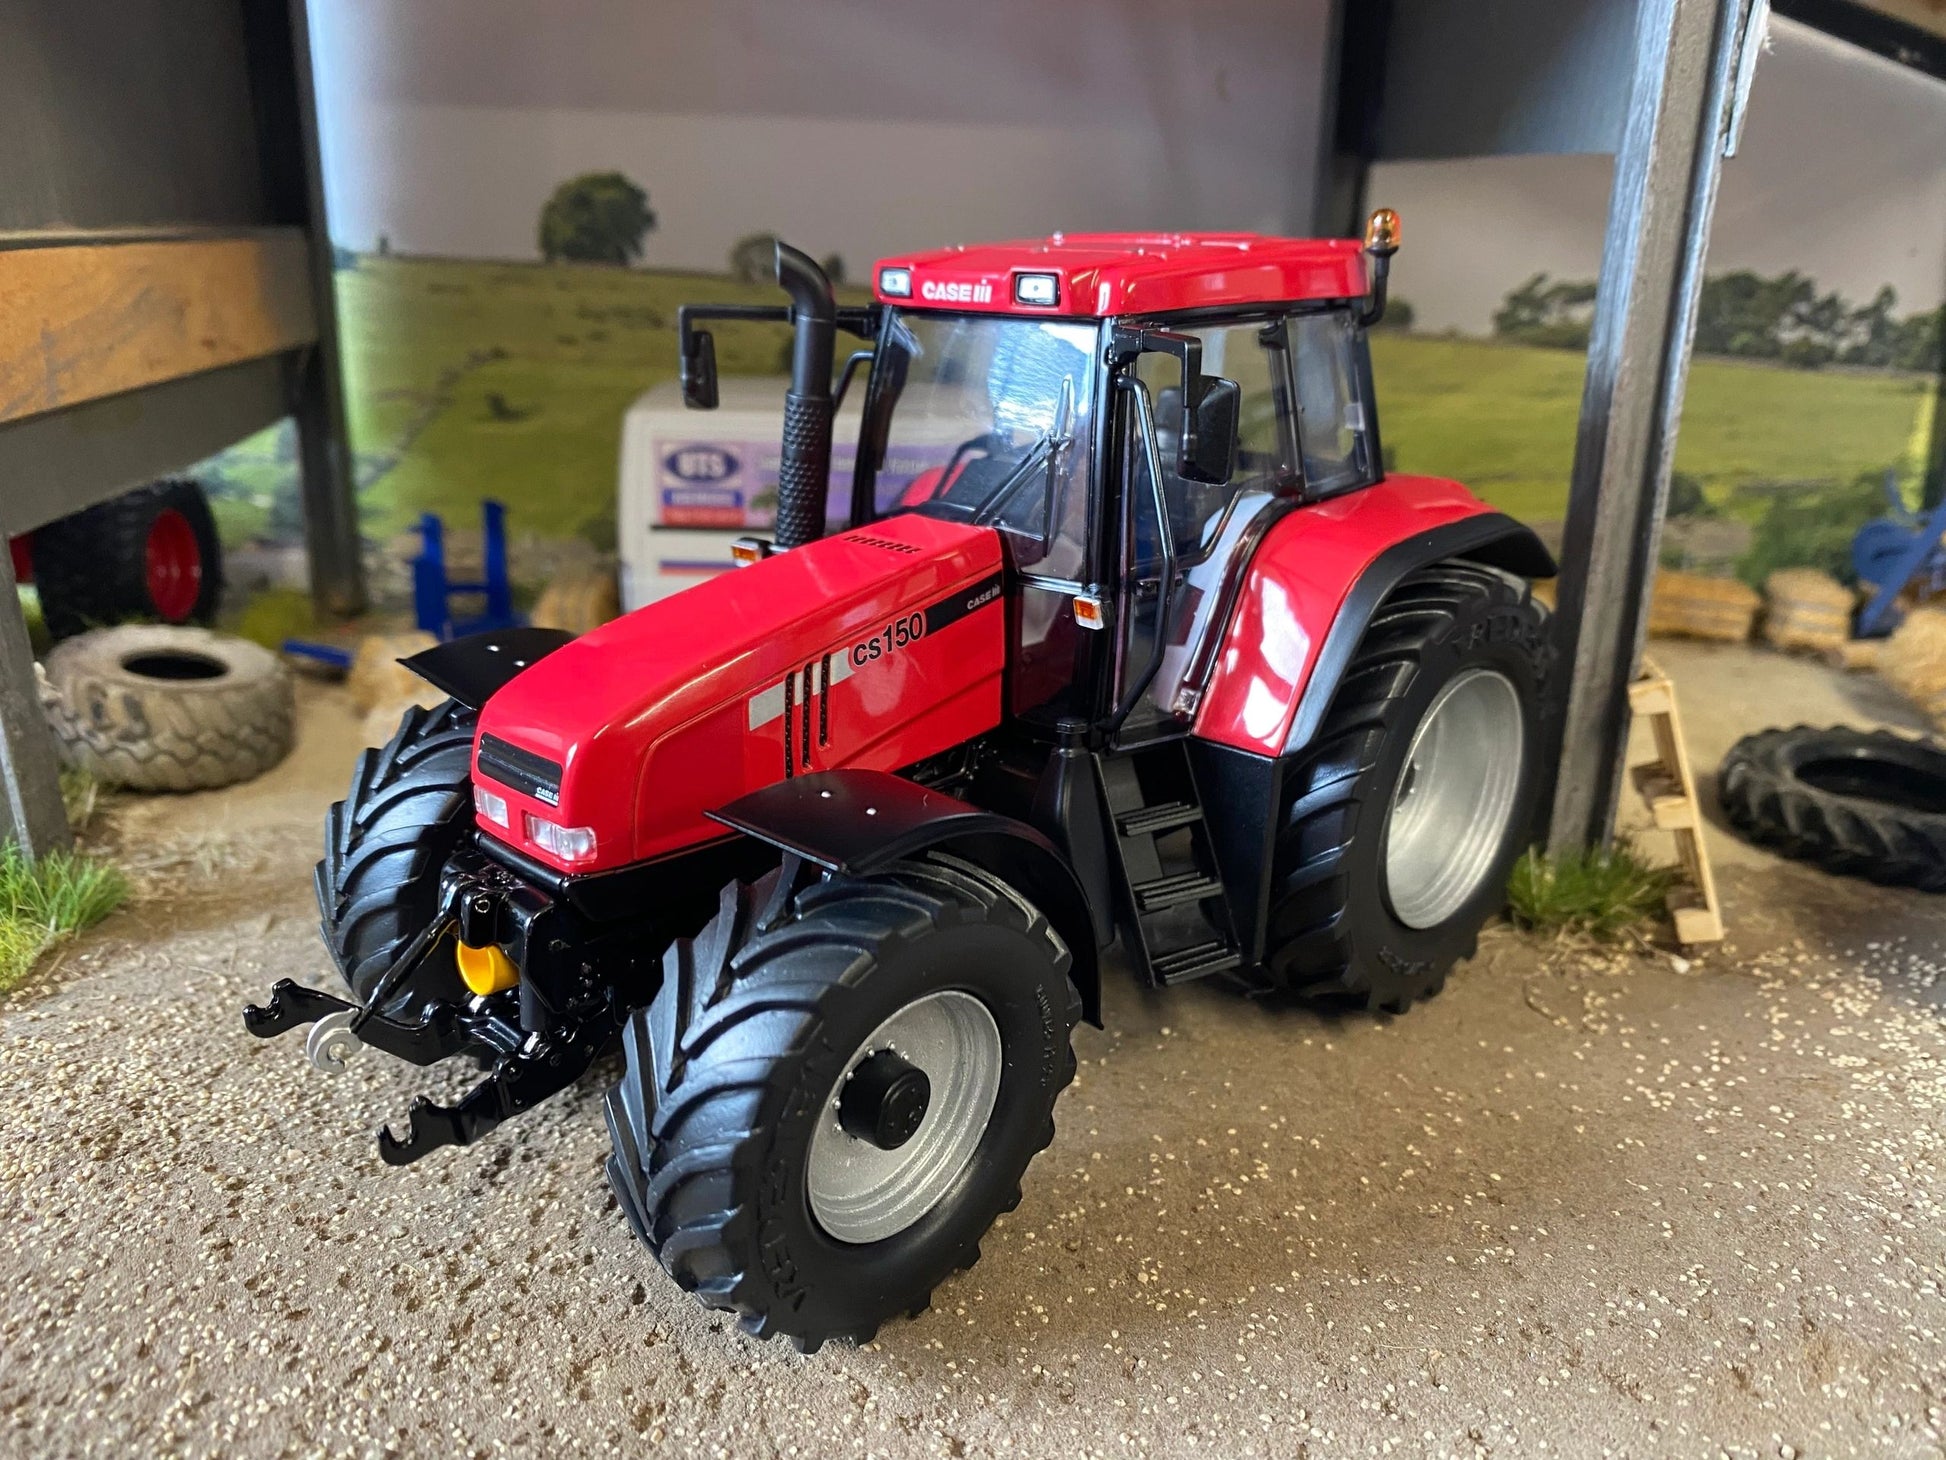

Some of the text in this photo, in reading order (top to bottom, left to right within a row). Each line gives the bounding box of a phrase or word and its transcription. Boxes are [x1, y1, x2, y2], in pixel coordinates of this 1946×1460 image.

[922, 281, 973, 302] CASE
[967, 591, 991, 609] CASE
[537, 787, 553, 799] CASE
